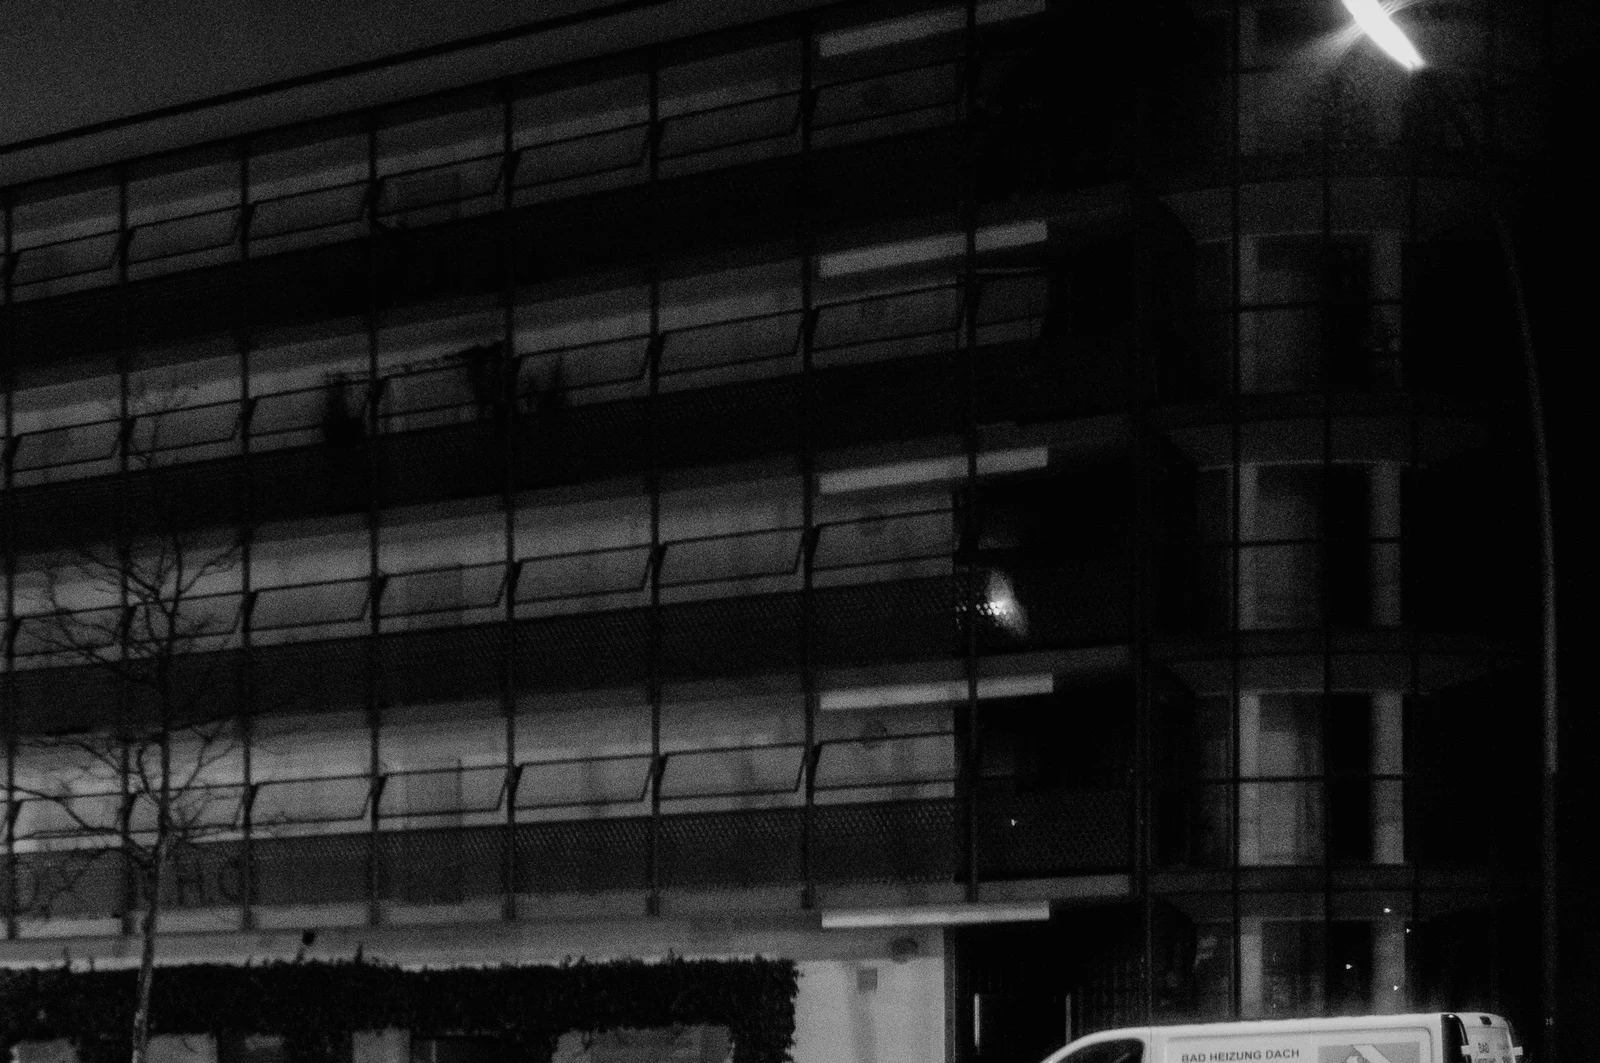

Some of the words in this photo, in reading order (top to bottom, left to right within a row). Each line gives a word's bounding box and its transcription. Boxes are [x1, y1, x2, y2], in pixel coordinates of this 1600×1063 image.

[1181, 1052, 1206, 1063] BAD
[1209, 1050, 1262, 1062] HEIZUNG
[1265, 1048, 1300, 1060] DACH
